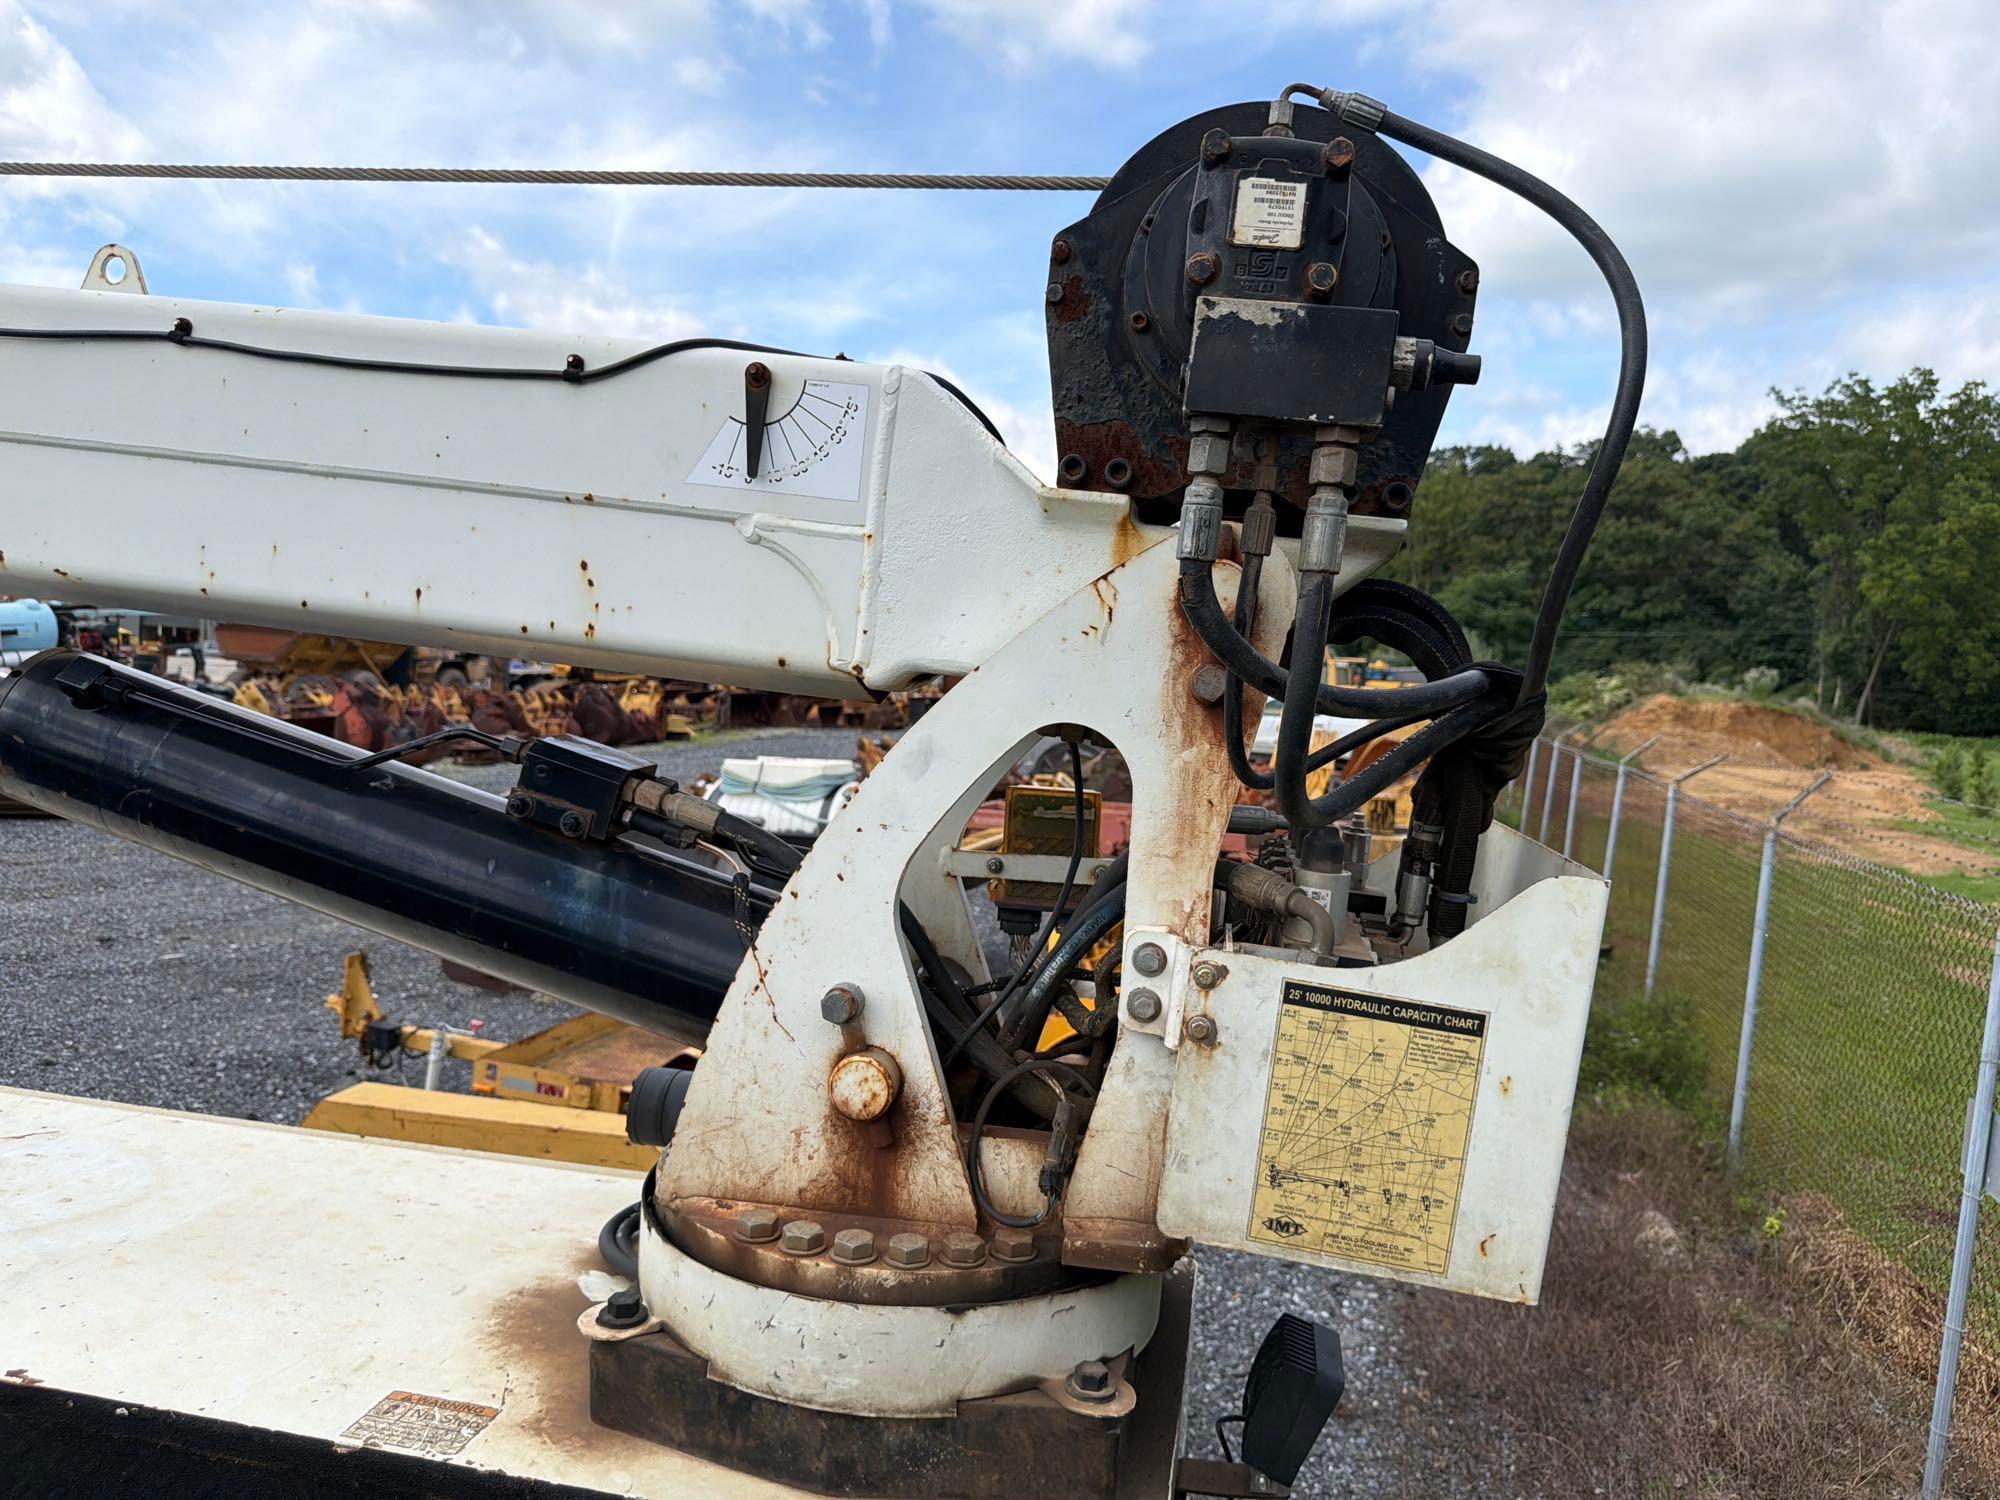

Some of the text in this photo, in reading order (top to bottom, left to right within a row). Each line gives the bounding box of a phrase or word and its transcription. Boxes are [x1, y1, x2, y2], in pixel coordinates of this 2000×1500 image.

[1288, 988, 1480, 1031] 25' 10000 HYDRAULIC CAPACITY CHART
[1266, 1217, 1303, 1235] IMT
[1360, 1239, 1387, 1248] TOOLING
[416, 1396, 486, 1413] WARNING
